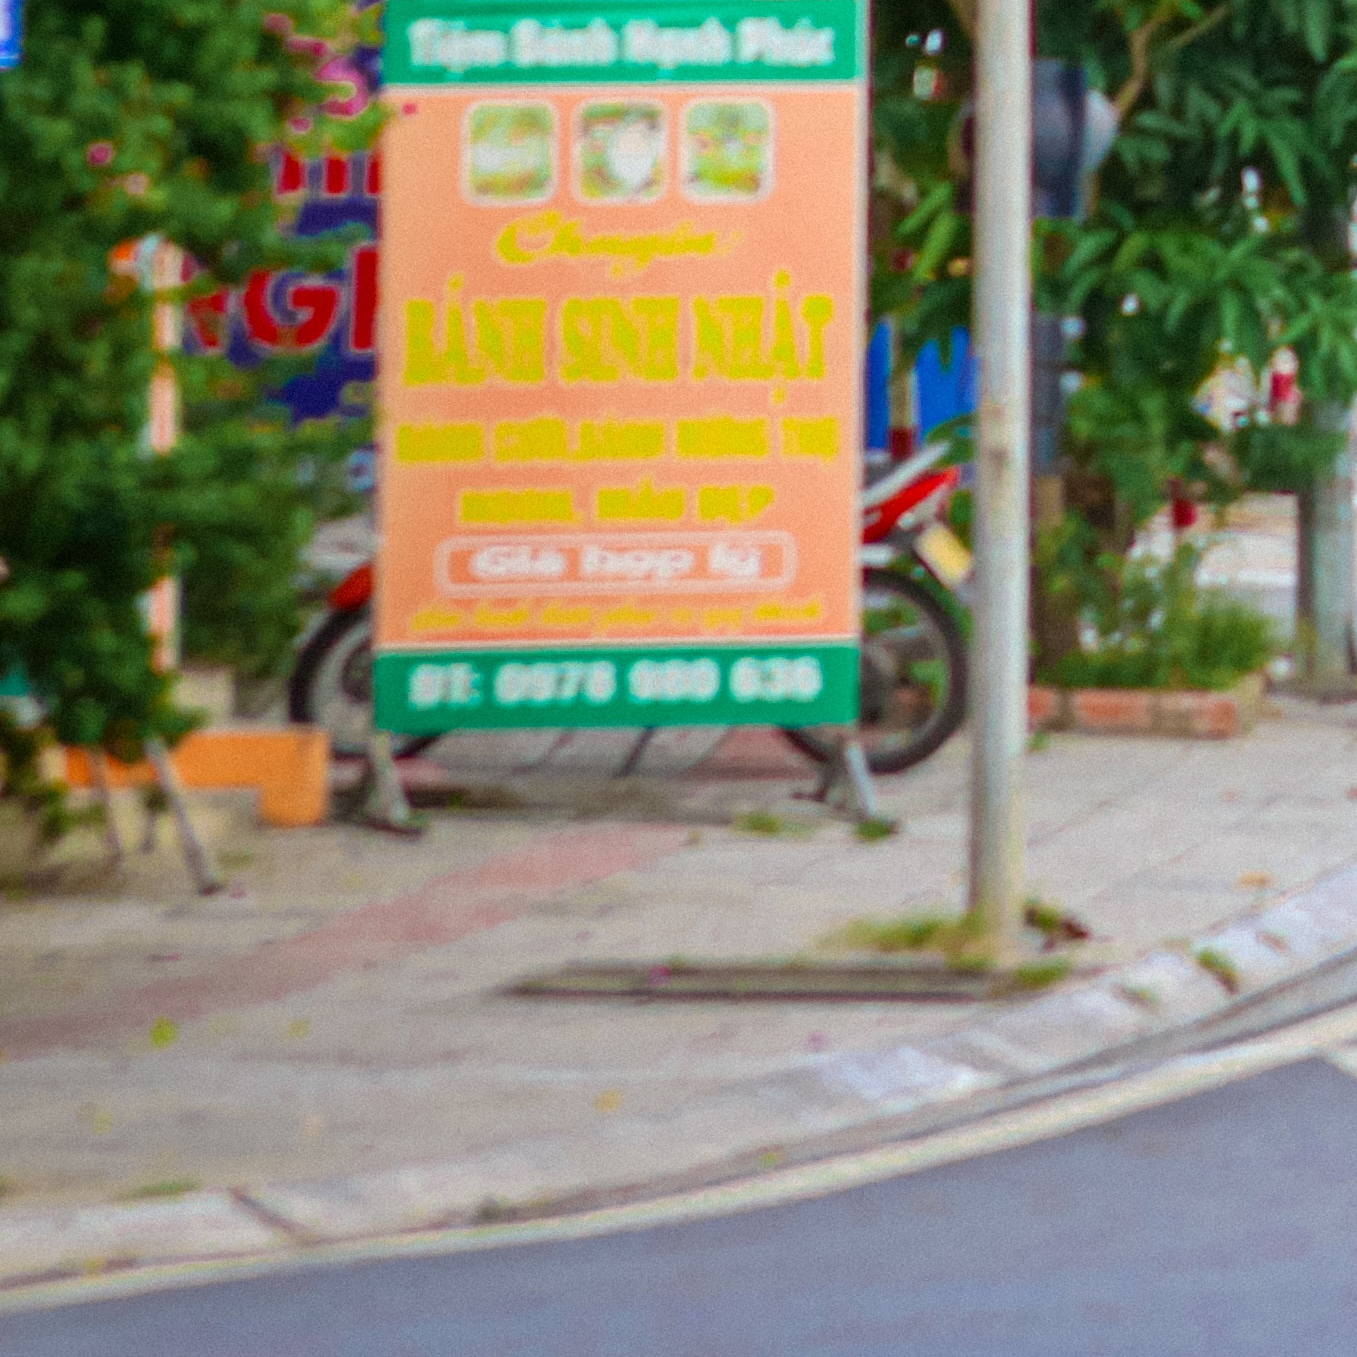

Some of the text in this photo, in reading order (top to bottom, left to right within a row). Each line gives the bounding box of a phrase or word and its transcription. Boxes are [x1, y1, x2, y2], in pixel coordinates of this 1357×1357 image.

[404, 272, 548, 386] BÁNH
[560, 295, 681, 383] SINH
[692, 268, 834, 406] NHẬT
